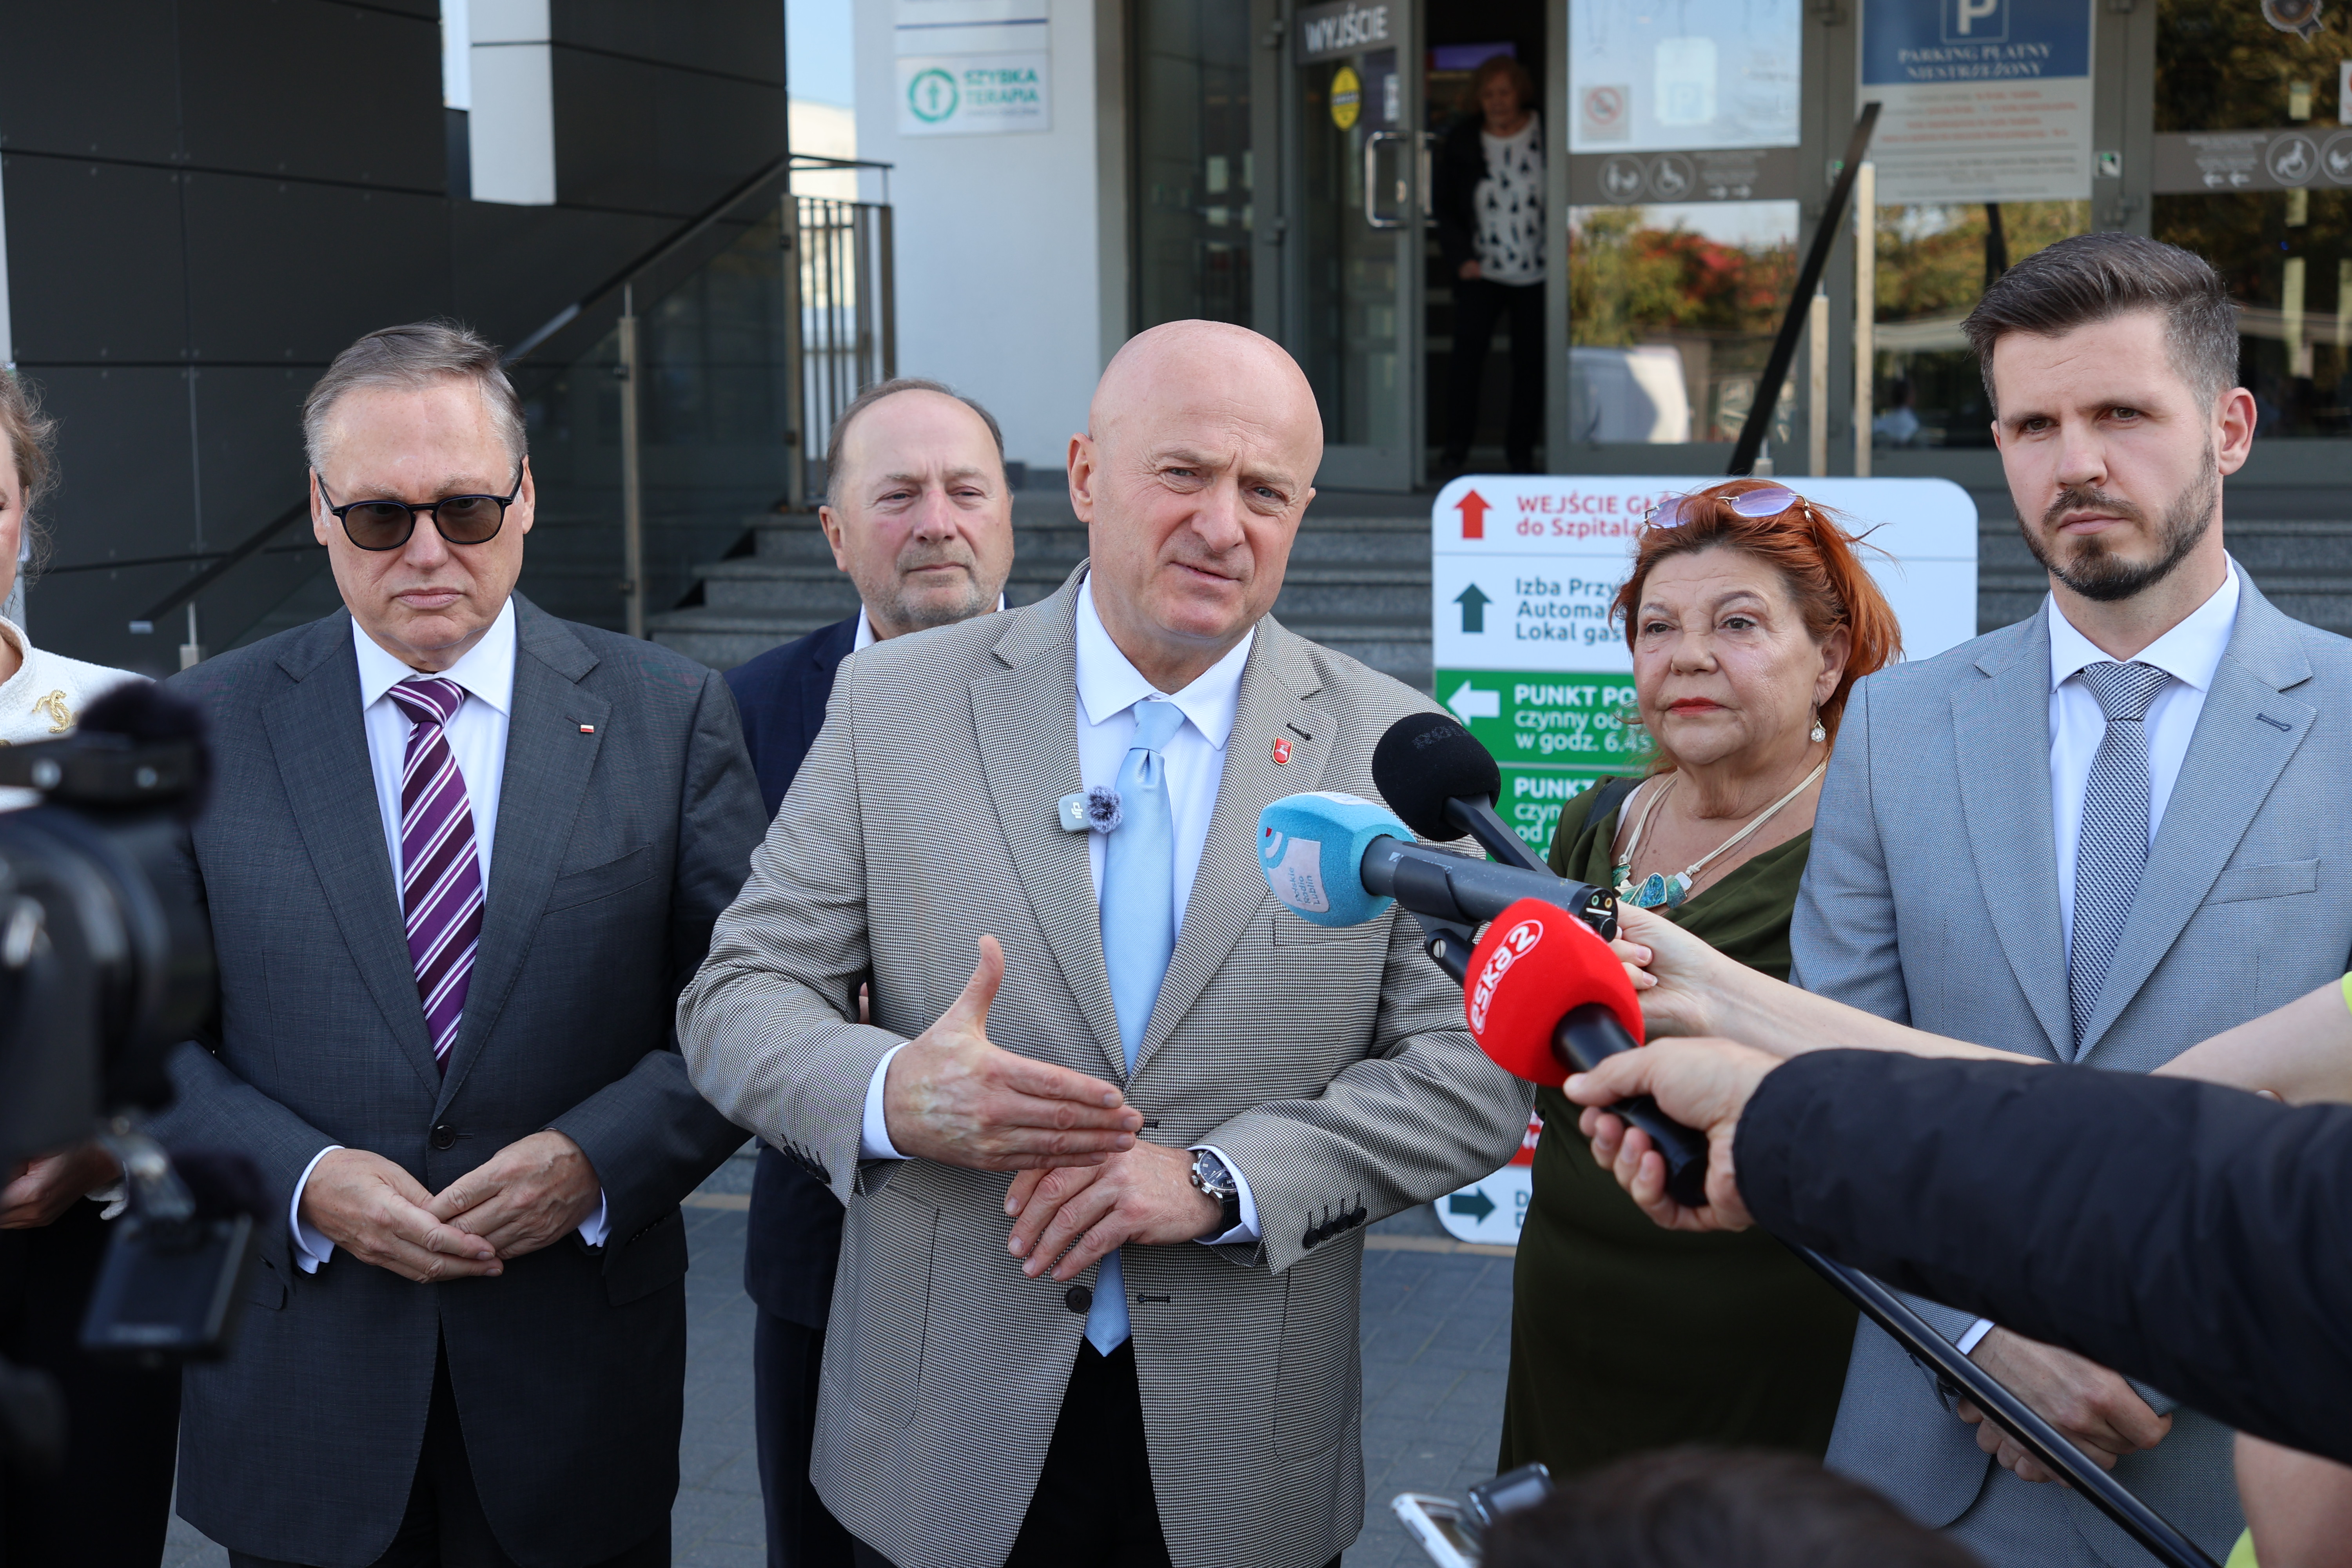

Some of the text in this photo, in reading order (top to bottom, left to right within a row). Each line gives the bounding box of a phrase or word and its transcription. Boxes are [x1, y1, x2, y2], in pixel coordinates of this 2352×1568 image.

[1305, 2, 1388, 53] WYJŚCIE
[1898, 46, 1978, 64] PARKING
[964, 68, 1039, 85] SZYBKA
[965, 88, 1039, 104] TERAPIA
[1517, 490, 1619, 514] WEJŚCIE
[1516, 517, 1544, 536] do
[1516, 577, 1561, 596] Izba
[1516, 622, 1576, 640] Lokal
[1514, 683, 1598, 707] PUNKT
[1514, 710, 1590, 733] czynny
[1514, 732, 1535, 750] w
[1539, 730, 1600, 755] godz.
[1288, 866, 1302, 903] Polskie
[1298, 875, 1311, 904] Radio
[1307, 875, 1321, 906] Lublin
